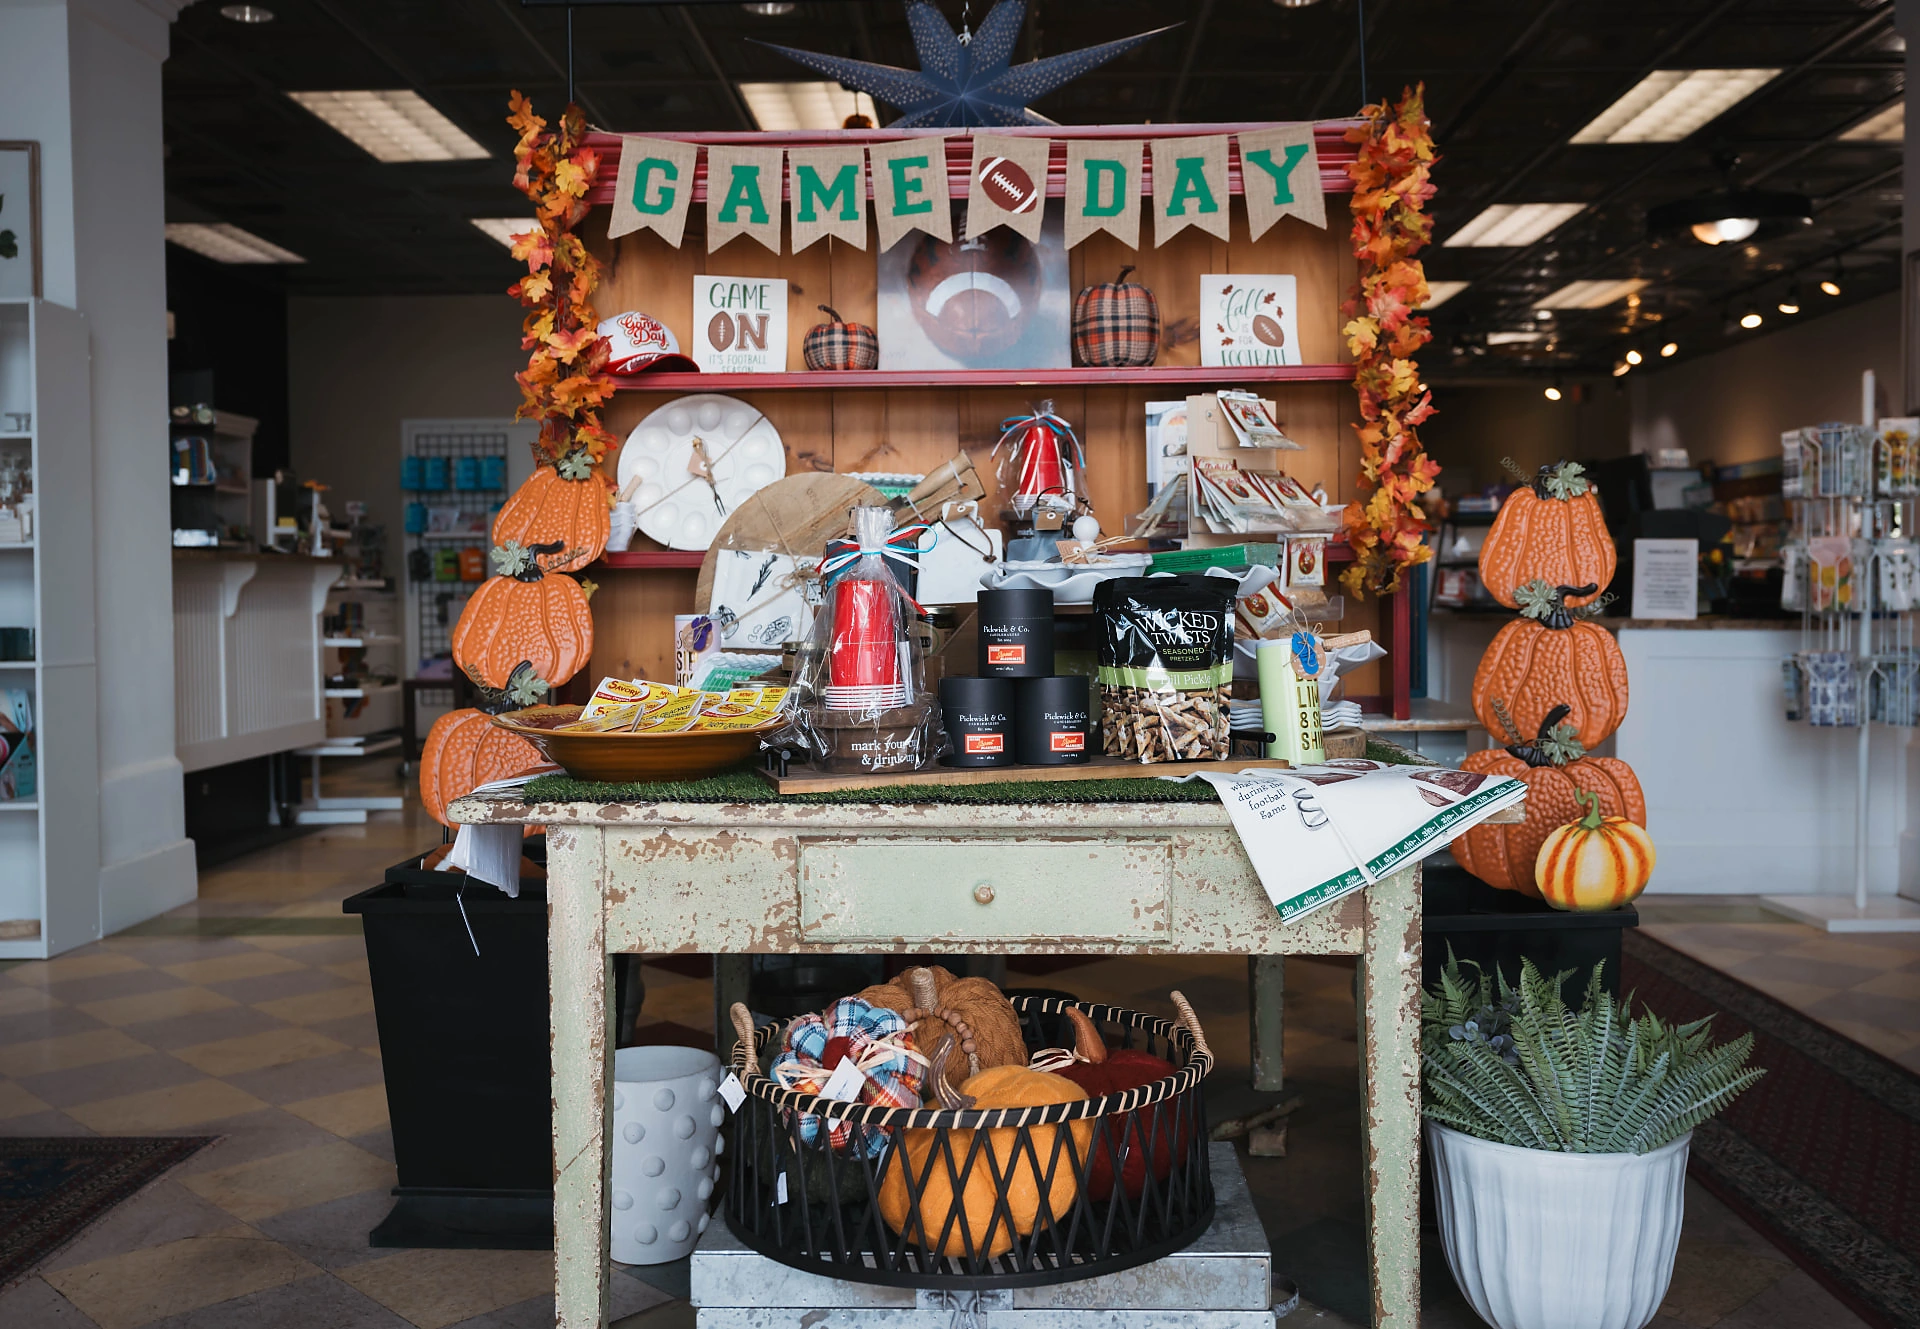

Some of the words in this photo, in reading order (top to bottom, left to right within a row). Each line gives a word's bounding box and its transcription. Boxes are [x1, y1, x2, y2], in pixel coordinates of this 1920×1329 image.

[632, 155, 933, 224] GAME
[1082, 143, 1309, 217] DAY
[709, 282, 771, 310] GAME
[620, 314, 662, 336] Game
[633, 330, 667, 349] Day
[709, 353, 724, 365] IT'S
[727, 353, 768, 365] FOOTBALL
[1135, 610, 1218, 632] WICKED
[1162, 647, 1205, 655] SEASONED
[959, 713, 989, 722] Pickwick
[1044, 712, 1074, 720] Pickwick
[851, 739, 882, 751] mark
[861, 753, 871, 765] &
[875, 753, 904, 765] drink
[907, 753, 915, 764] up
[1238, 784, 1269, 802] during
[1269, 781, 1285, 790] the
[1248, 788, 1286, 811] football
[1259, 804, 1287, 820] game
